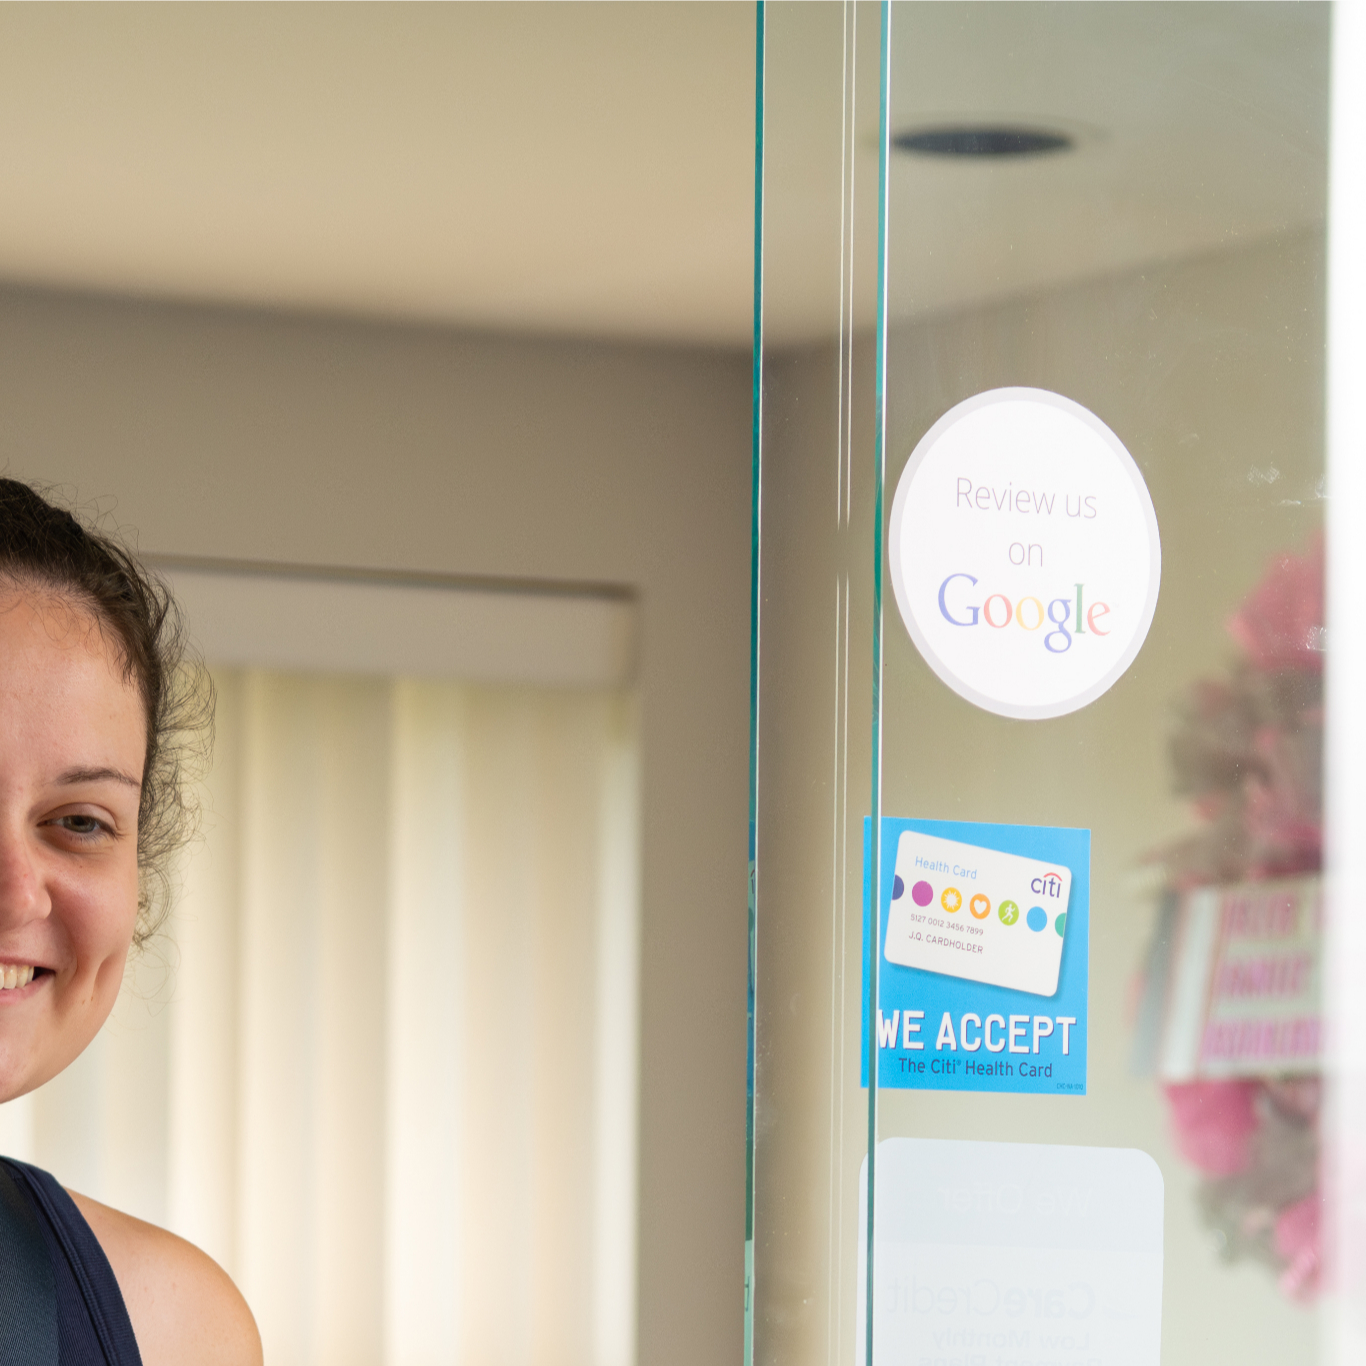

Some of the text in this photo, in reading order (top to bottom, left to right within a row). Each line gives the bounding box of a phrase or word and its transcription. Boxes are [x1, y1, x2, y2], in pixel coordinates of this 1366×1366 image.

[954, 475, 1098, 519] Review us
[1007, 538, 1044, 567] on
[937, 572, 1112, 654] Google
[914, 855, 978, 880] Health Card
[1030, 872, 1063, 899] citi
[910, 913, 984, 936] 5127 0012 3456 7899
[908, 931, 984, 954] J.Q. CARDHOLDER
[877, 1009, 1077, 1056] WE ACCEPT
[899, 1058, 926, 1074] The
[965, 1060, 1014, 1077] Health
[1019, 1062, 1053, 1078] Card
